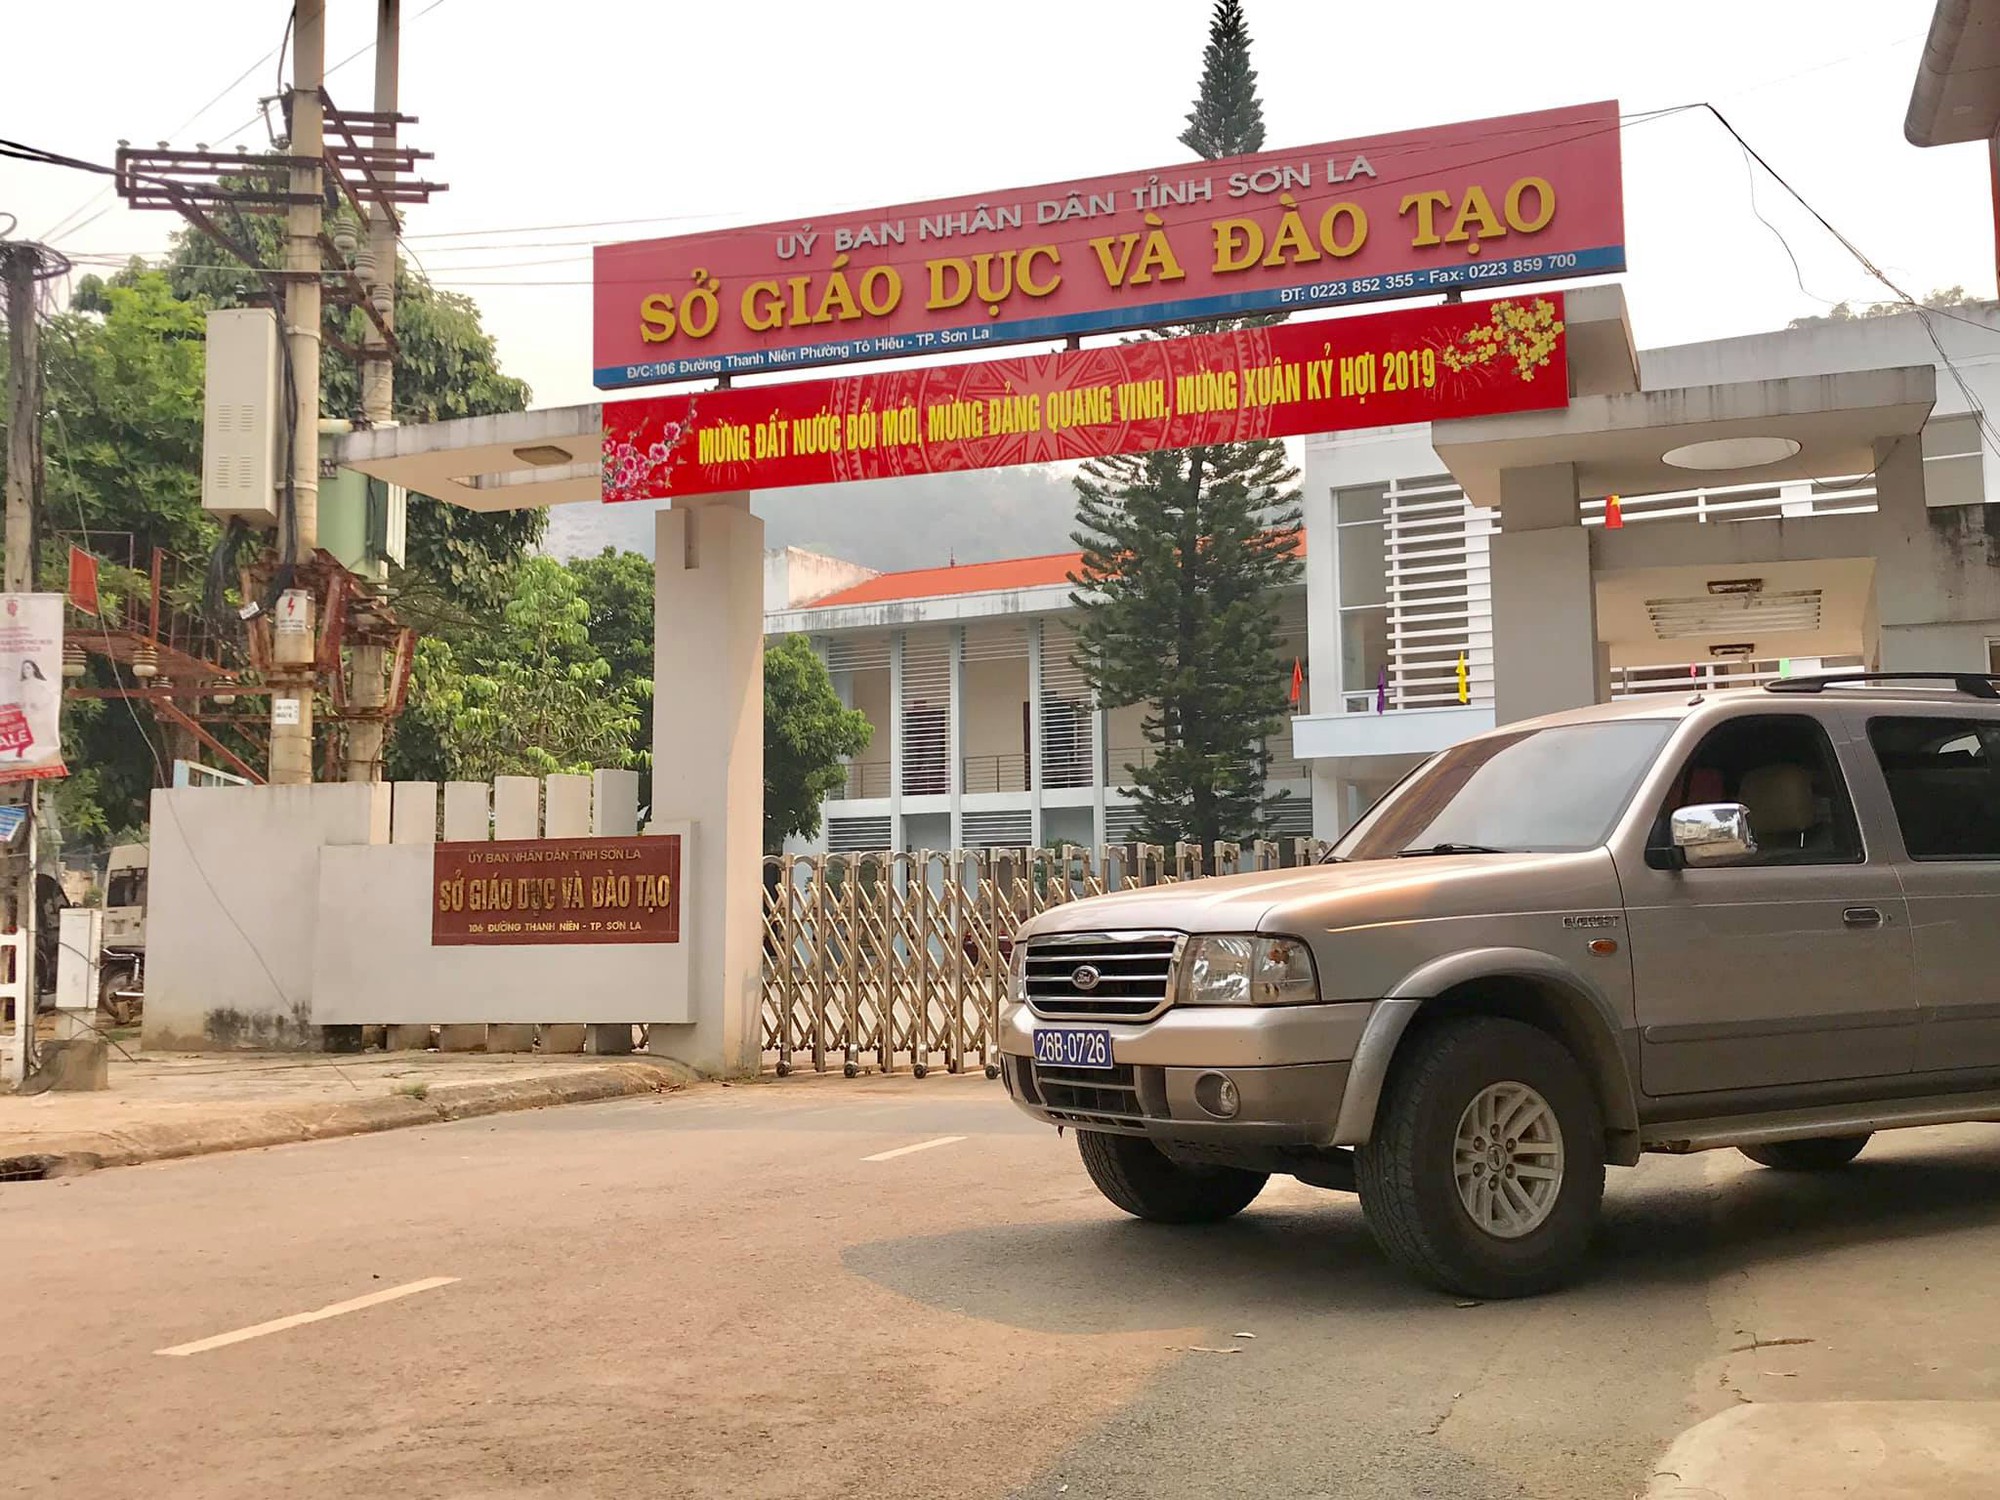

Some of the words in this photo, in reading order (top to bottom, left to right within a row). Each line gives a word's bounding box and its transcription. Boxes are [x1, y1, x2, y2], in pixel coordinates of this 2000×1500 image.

[776, 223, 818, 260] UỶ
[835, 220, 905, 252] BAN
[919, 203, 1022, 241] NHÂN
[1037, 189, 1116, 225] DÂN
[1133, 175, 1212, 211] TỈNH
[1228, 162, 1311, 197] SƠN
[1328, 155, 1377, 185] LA
[639, 267, 722, 344] SỞ
[740, 254, 904, 333] GIÁO
[925, 244, 1062, 317] DỤC
[1089, 212, 1186, 288] VÀ
[1212, 193, 1369, 276] ĐÀO
[1399, 176, 1556, 256] TẠO
[1281, 287, 1304, 304] ĐT:
[1309, 280, 1347, 301] 0223
[1351, 275, 1380, 294] 852
[1385, 271, 1414, 290] 355
[1429, 267, 1464, 286] Fax:
[1468, 258, 1508, 280] 0223
[1512, 256, 1543, 274] 859
[1547, 252, 1577, 270] 700
[680, 358, 721, 373] Đường
[725, 353, 764, 368] Thanh
[768, 348, 796, 363] Niên
[800, 344, 849, 361] Phường
[916, 332, 937, 347] TP.
[941, 329, 967, 345] Sơn
[972, 325, 990, 341] La
[698, 418, 751, 465] MỪNG
[755, 408, 788, 460] ĐẤT
[793, 405, 842, 456] NƯỚC
[847, 397, 877, 450] ĐỔI
[882, 397, 923, 448] MỚI,
[928, 394, 984, 443] MỪNG
[990, 380, 1041, 436] ĐẢNG
[1046, 386, 1113, 433] QUANG
[1117, 379, 1171, 422] VINH,
[1176, 364, 1238, 416] MỪNG
[1243, 357, 1301, 408] XUÂN
[1307, 342, 1334, 400] KỶ
[1340, 352, 1376, 404] HỢI
[1382, 348, 1436, 392] 2019
[486, 852, 509, 864] BAN
[512, 849, 543, 862] NHÂN
[626, 848, 642, 859] LA
[439, 868, 465, 912] SỞ
[469, 871, 513, 910] GIÁO
[517, 877, 555, 918] DỤC
[561, 869, 585, 909] VÀ
[591, 869, 630, 908] ĐÀO
[636, 874, 671, 913] TẠO
[468, 924, 483, 932] 106
[525, 922, 556, 932] THANH
[606, 920, 626, 931] SƠN
[629, 922, 642, 931] LA
[1562, 915, 1619, 928] EVEREST
